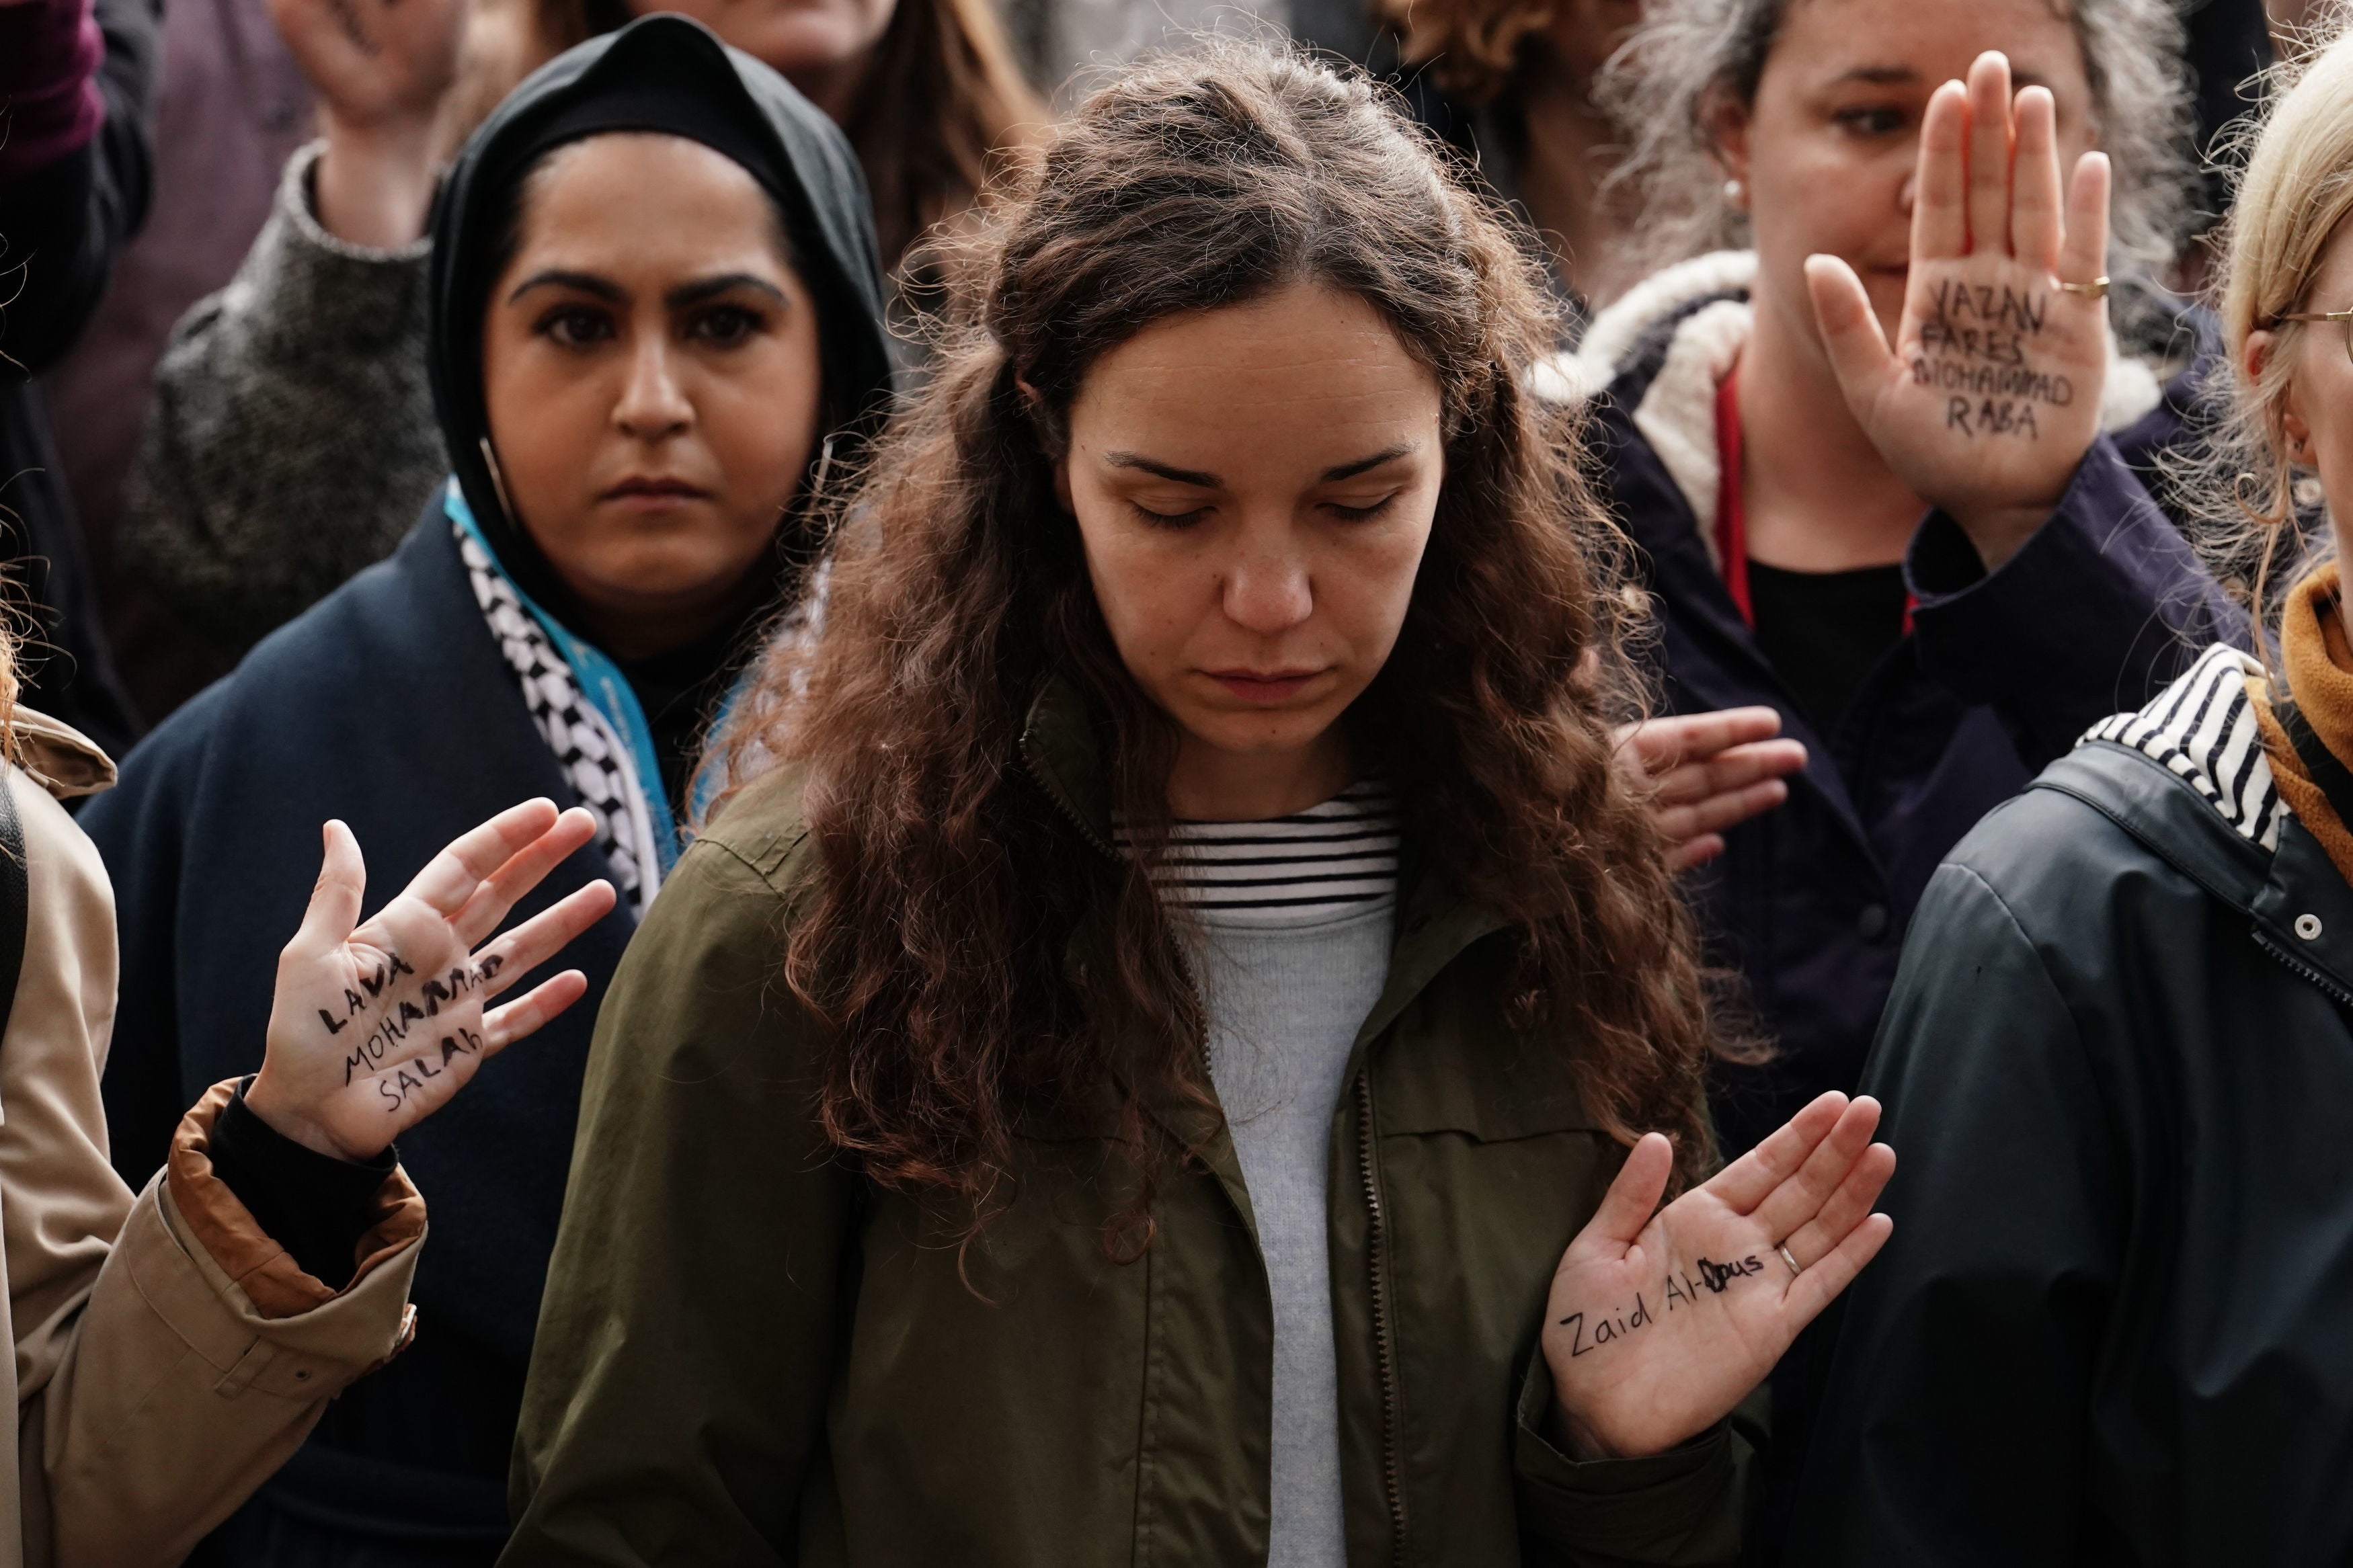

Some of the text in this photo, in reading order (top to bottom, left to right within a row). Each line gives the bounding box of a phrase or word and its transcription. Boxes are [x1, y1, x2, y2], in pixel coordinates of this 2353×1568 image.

[1928, 279, 2046, 335] YAZAN
[1919, 322, 2025, 366] FARES
[1946, 396, 2039, 441] RABA
[319, 952, 413, 1034] LAVA
[1560, 1292, 1652, 1356] Zaid
